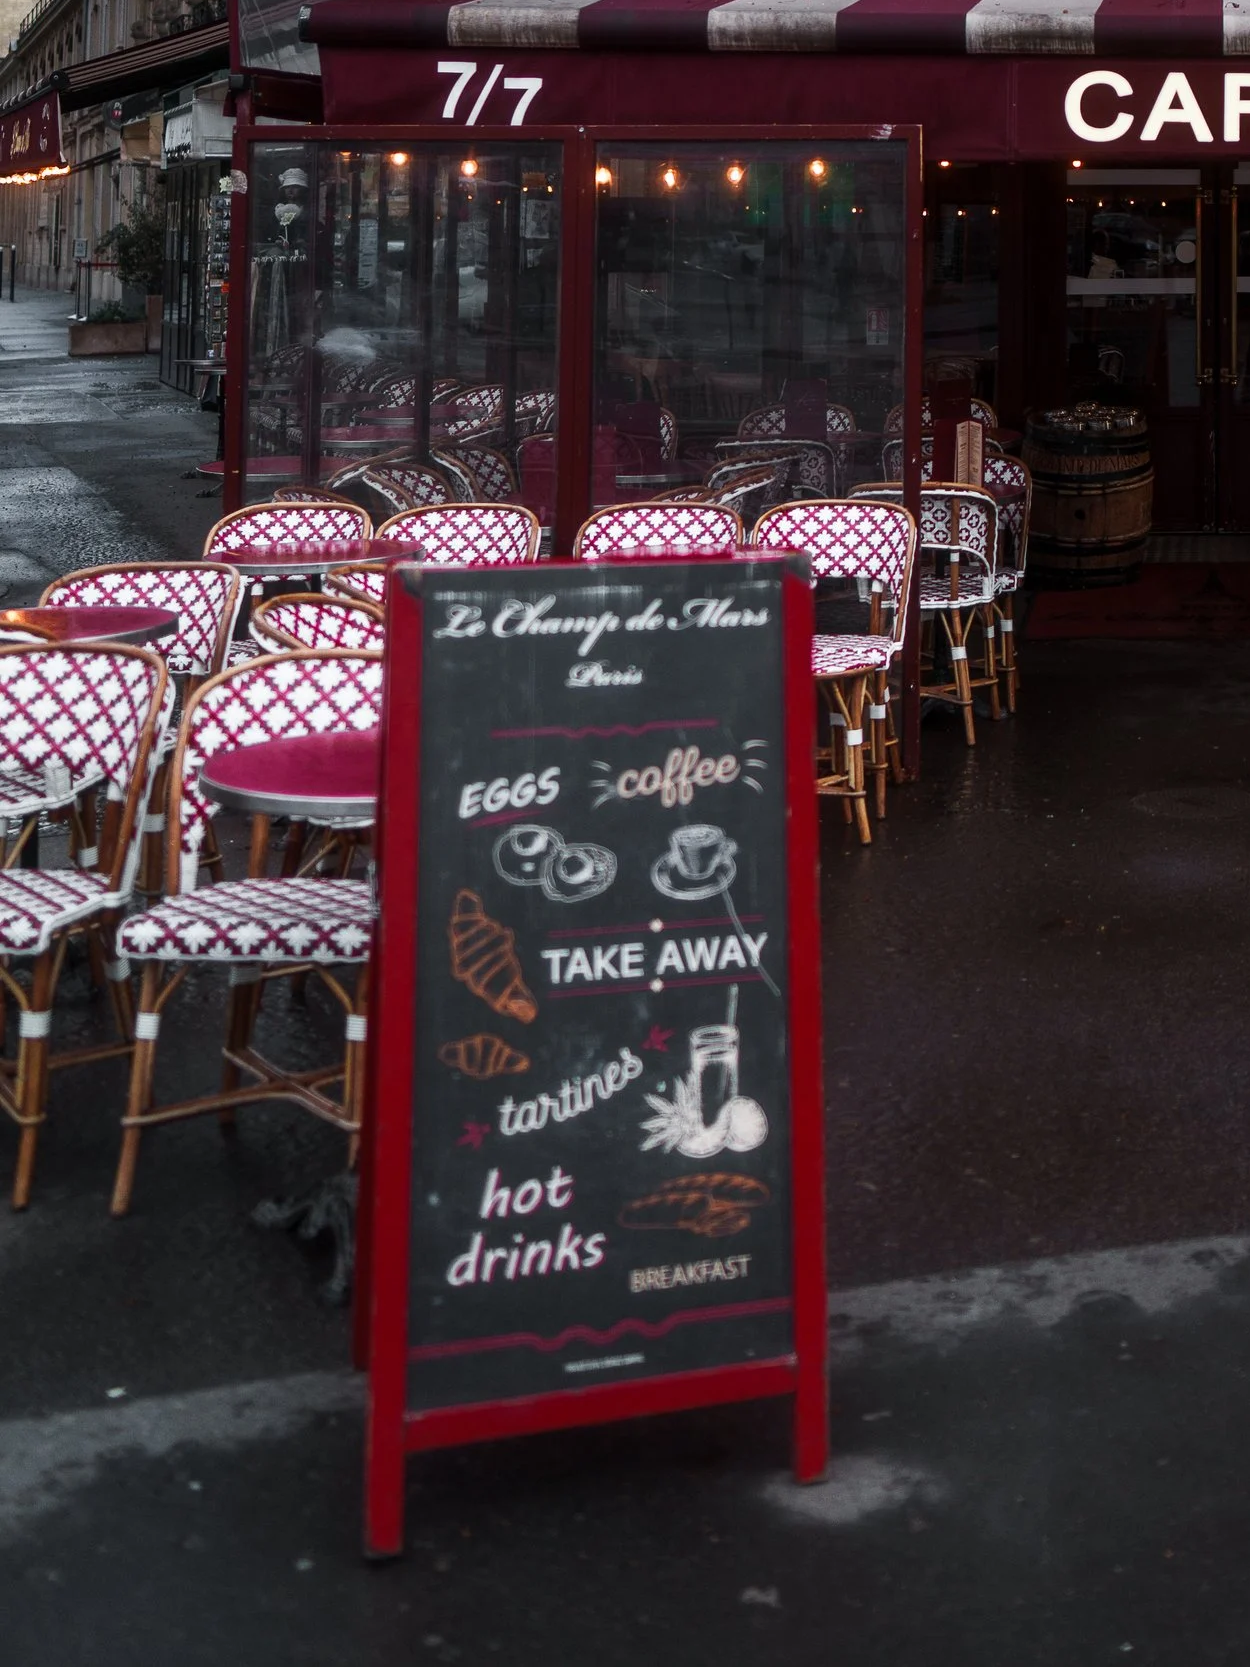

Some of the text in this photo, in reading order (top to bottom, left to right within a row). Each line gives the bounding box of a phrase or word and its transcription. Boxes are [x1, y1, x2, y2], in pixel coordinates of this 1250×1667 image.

[437, 61, 543, 126] 7/7
[433, 593, 772, 657] Le Champ de Mars
[458, 766, 562, 819] EGGS
[616, 745, 742, 809] coffee
[540, 932, 768, 984] TAKE AWAY
[497, 1046, 645, 1136] tartines
[478, 1164, 574, 1220] hot
[446, 1221, 608, 1287] drinks
[628, 1253, 753, 1294] BREAKFAST
